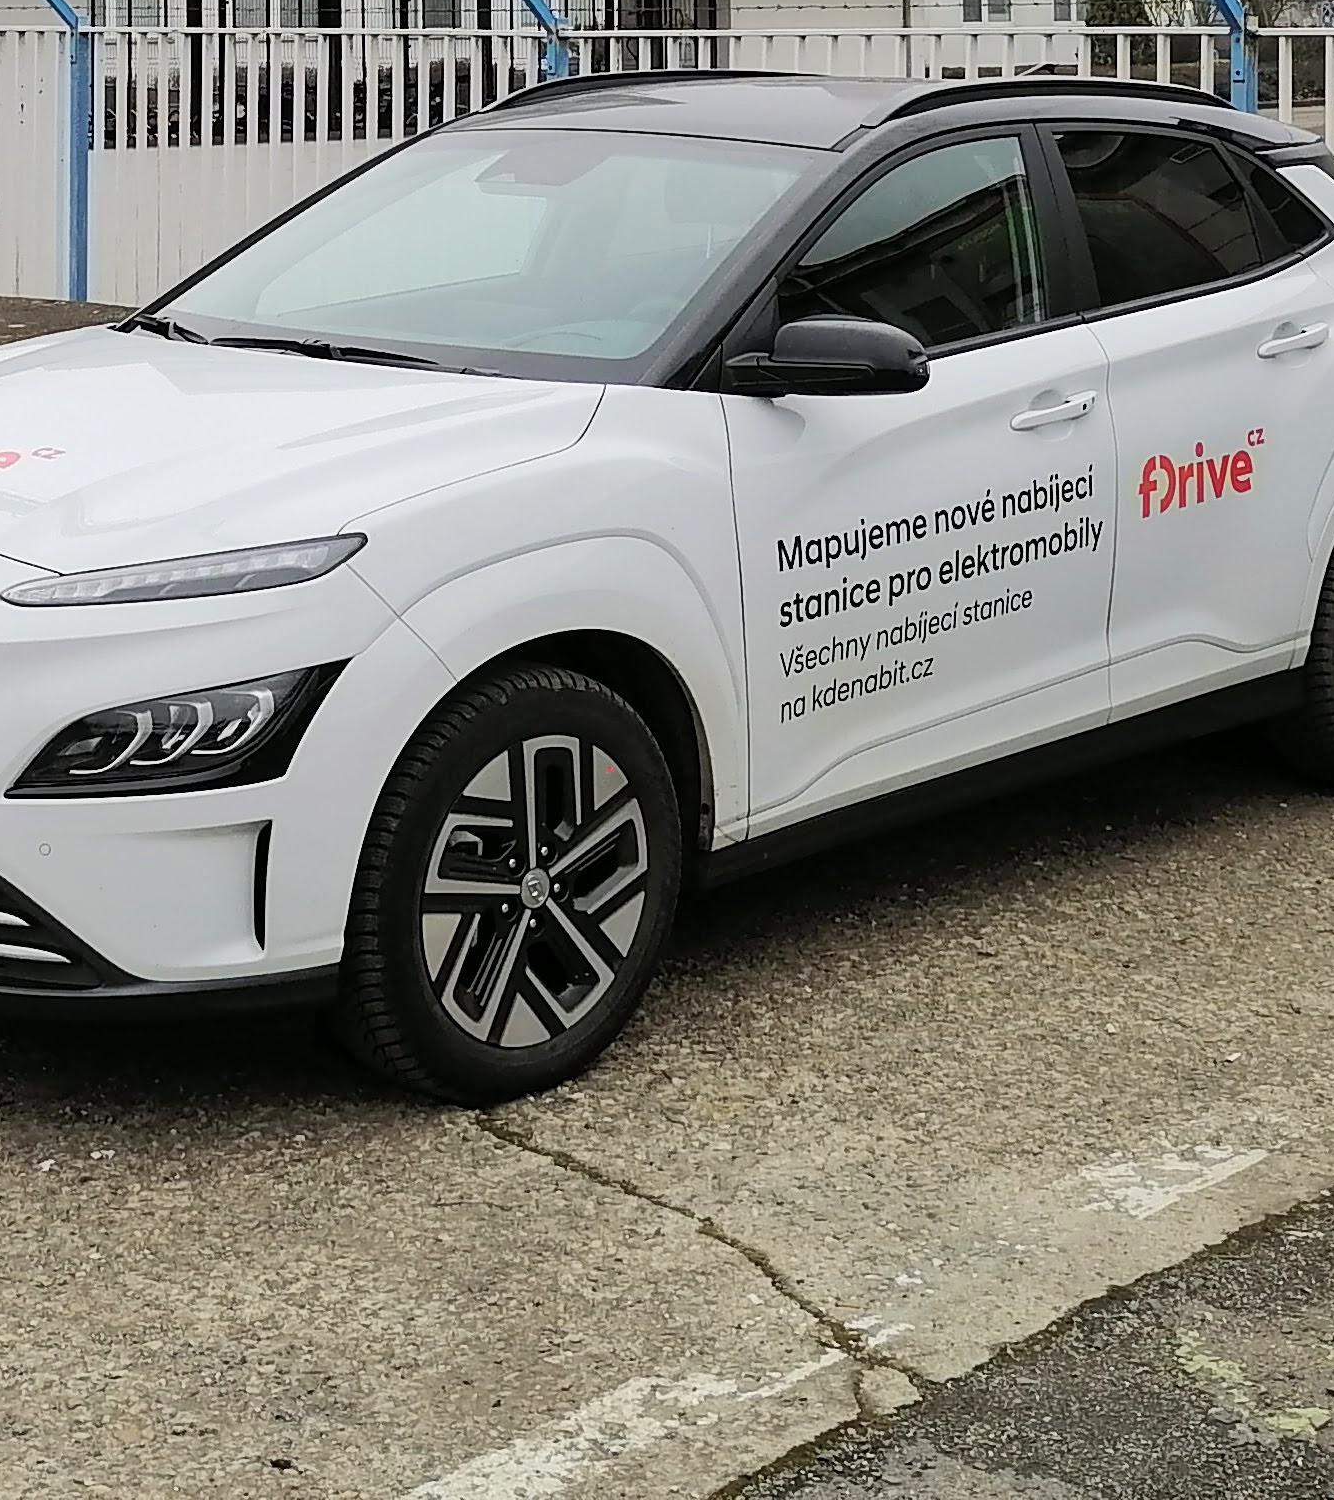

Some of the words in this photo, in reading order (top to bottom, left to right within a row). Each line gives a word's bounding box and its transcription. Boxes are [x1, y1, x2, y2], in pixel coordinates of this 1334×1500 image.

[777, 514, 927, 572] Mapujeme
[934, 488, 995, 534] nové
[1002, 464, 1093, 519] nabíjecí
[1139, 442, 1253, 518] fDrive
[779, 576, 881, 629] stanice
[889, 566, 932, 607] pro
[938, 516, 1103, 585] elektromobily
[779, 633, 872, 678] Všechny
[876, 602, 958, 651] nabíjecí
[962, 588, 1033, 626] stanice
[780, 696, 806, 724] na
[812, 657, 935, 712] kdenabit.cz
